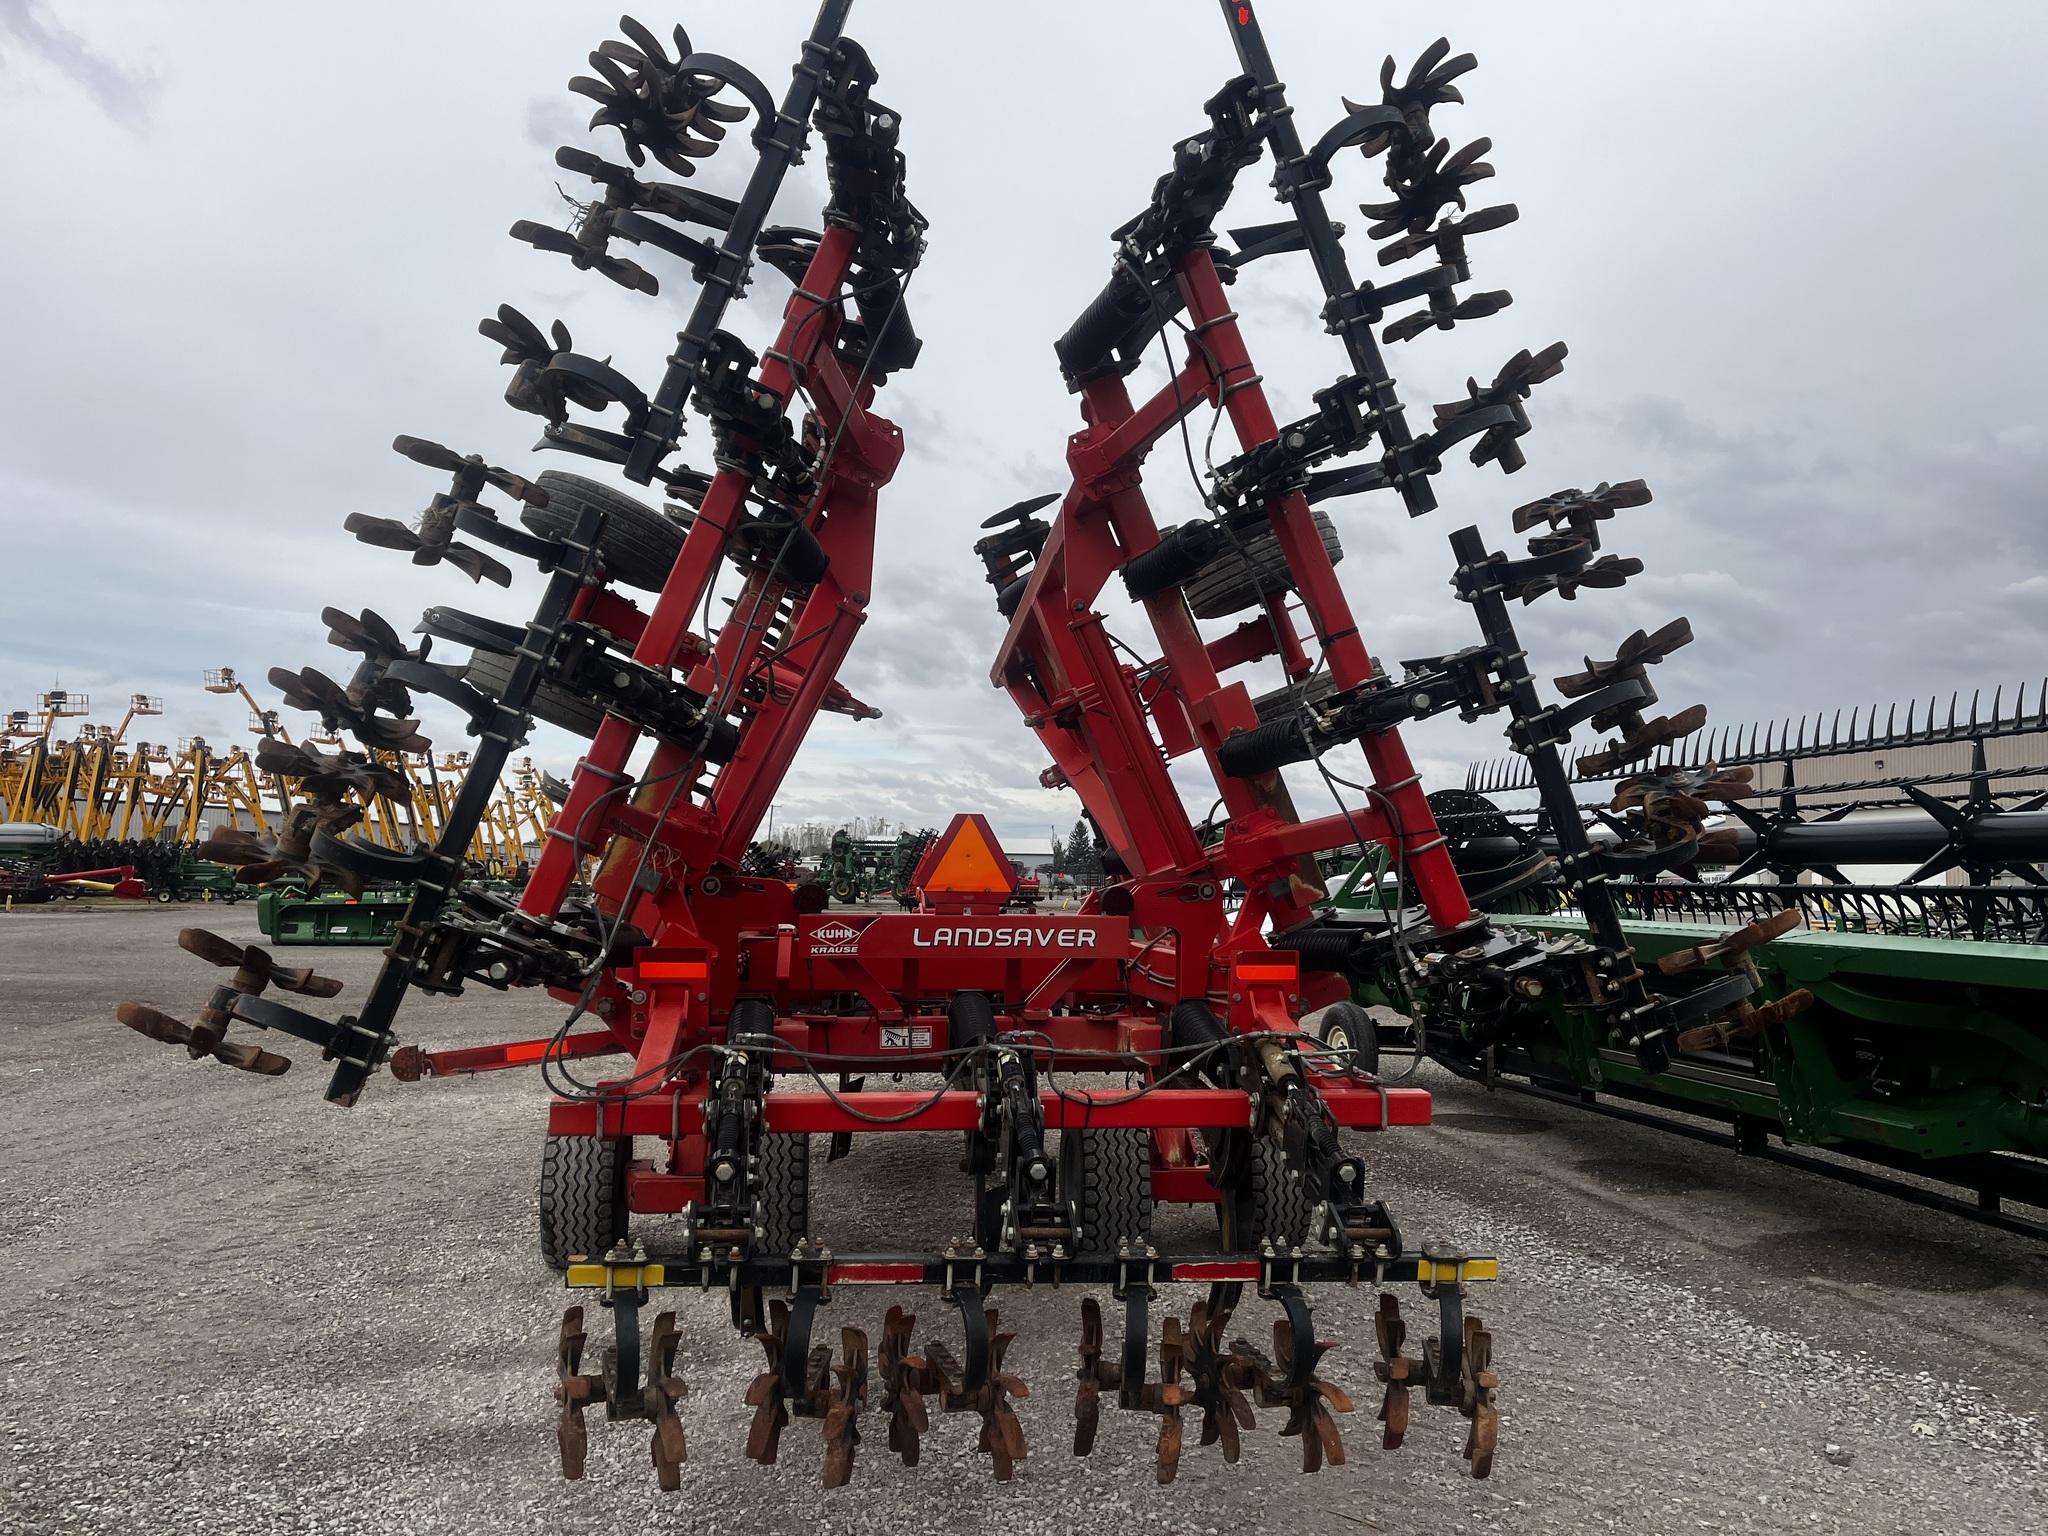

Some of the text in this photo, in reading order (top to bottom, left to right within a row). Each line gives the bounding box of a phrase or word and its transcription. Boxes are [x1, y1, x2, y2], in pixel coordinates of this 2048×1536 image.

[817, 929, 853, 939] KUHN
[913, 928, 1097, 948] LANDSAVER
[810, 946, 859, 954] KRAUSE
